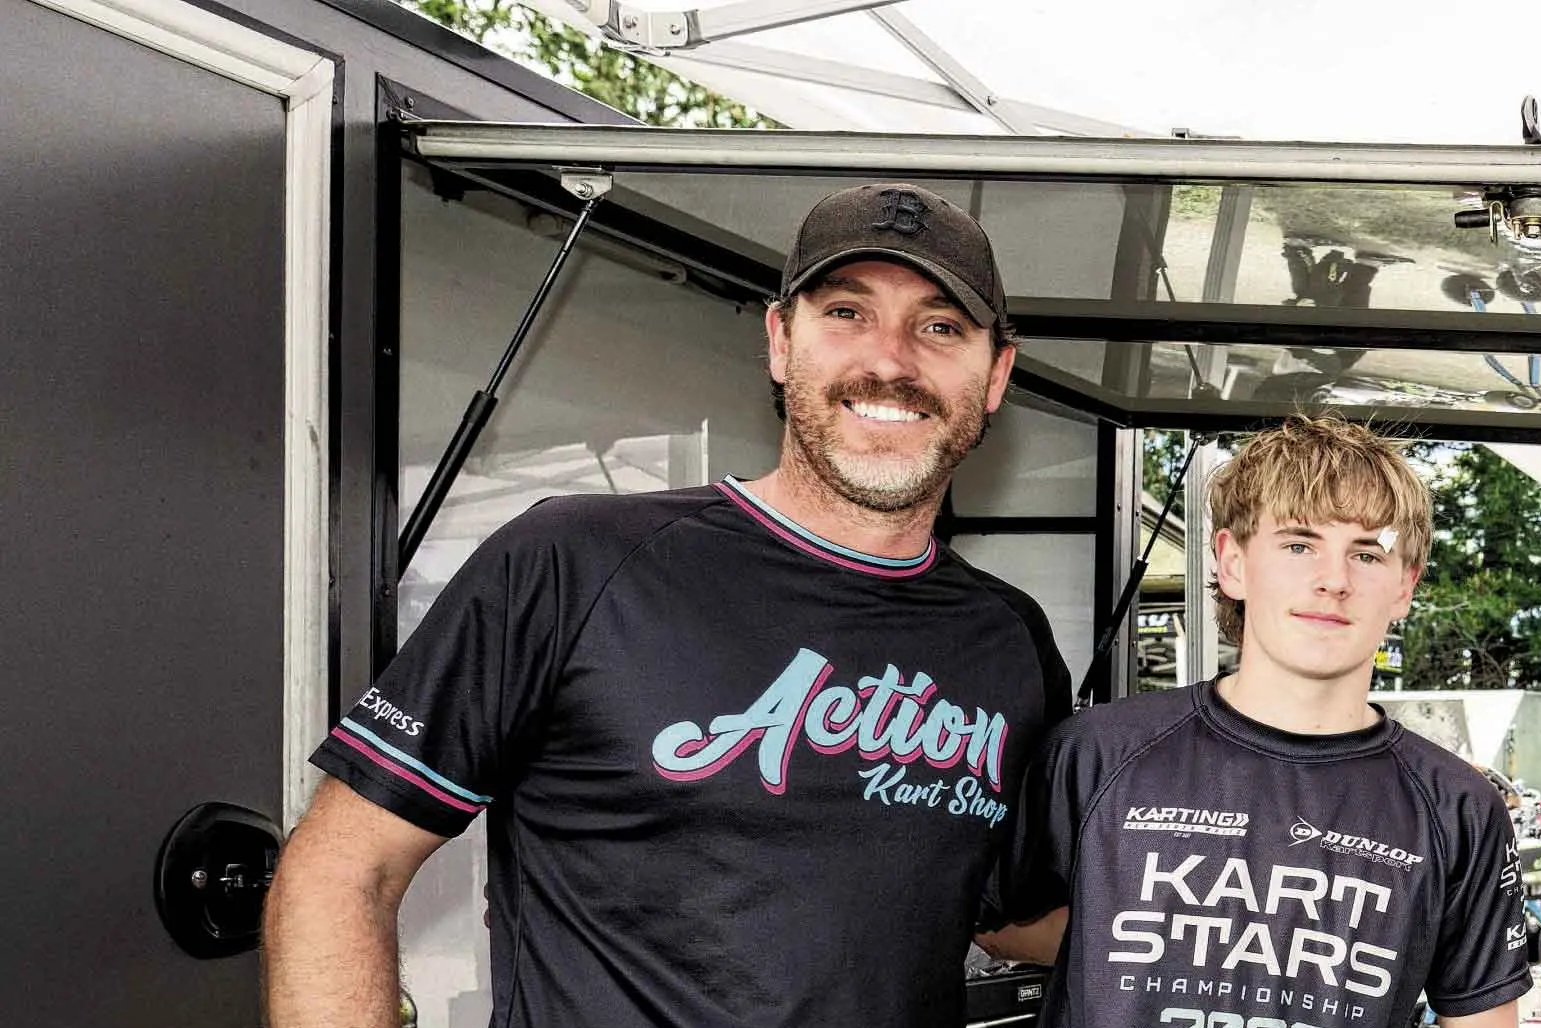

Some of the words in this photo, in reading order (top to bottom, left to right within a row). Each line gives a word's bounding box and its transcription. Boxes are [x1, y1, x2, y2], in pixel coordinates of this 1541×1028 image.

[360, 686, 424, 736] Express
[652, 647, 1009, 796] Action
[857, 762, 951, 808] Kart
[948, 776, 1009, 829] Shop
[1126, 807, 1236, 827] KARTING
[1323, 830, 1425, 864] DUNLOP
[1140, 852, 1392, 929] KART
[1107, 911, 1398, 998] STARS
[1119, 975, 1365, 1021] CHAMPIONSHIP
